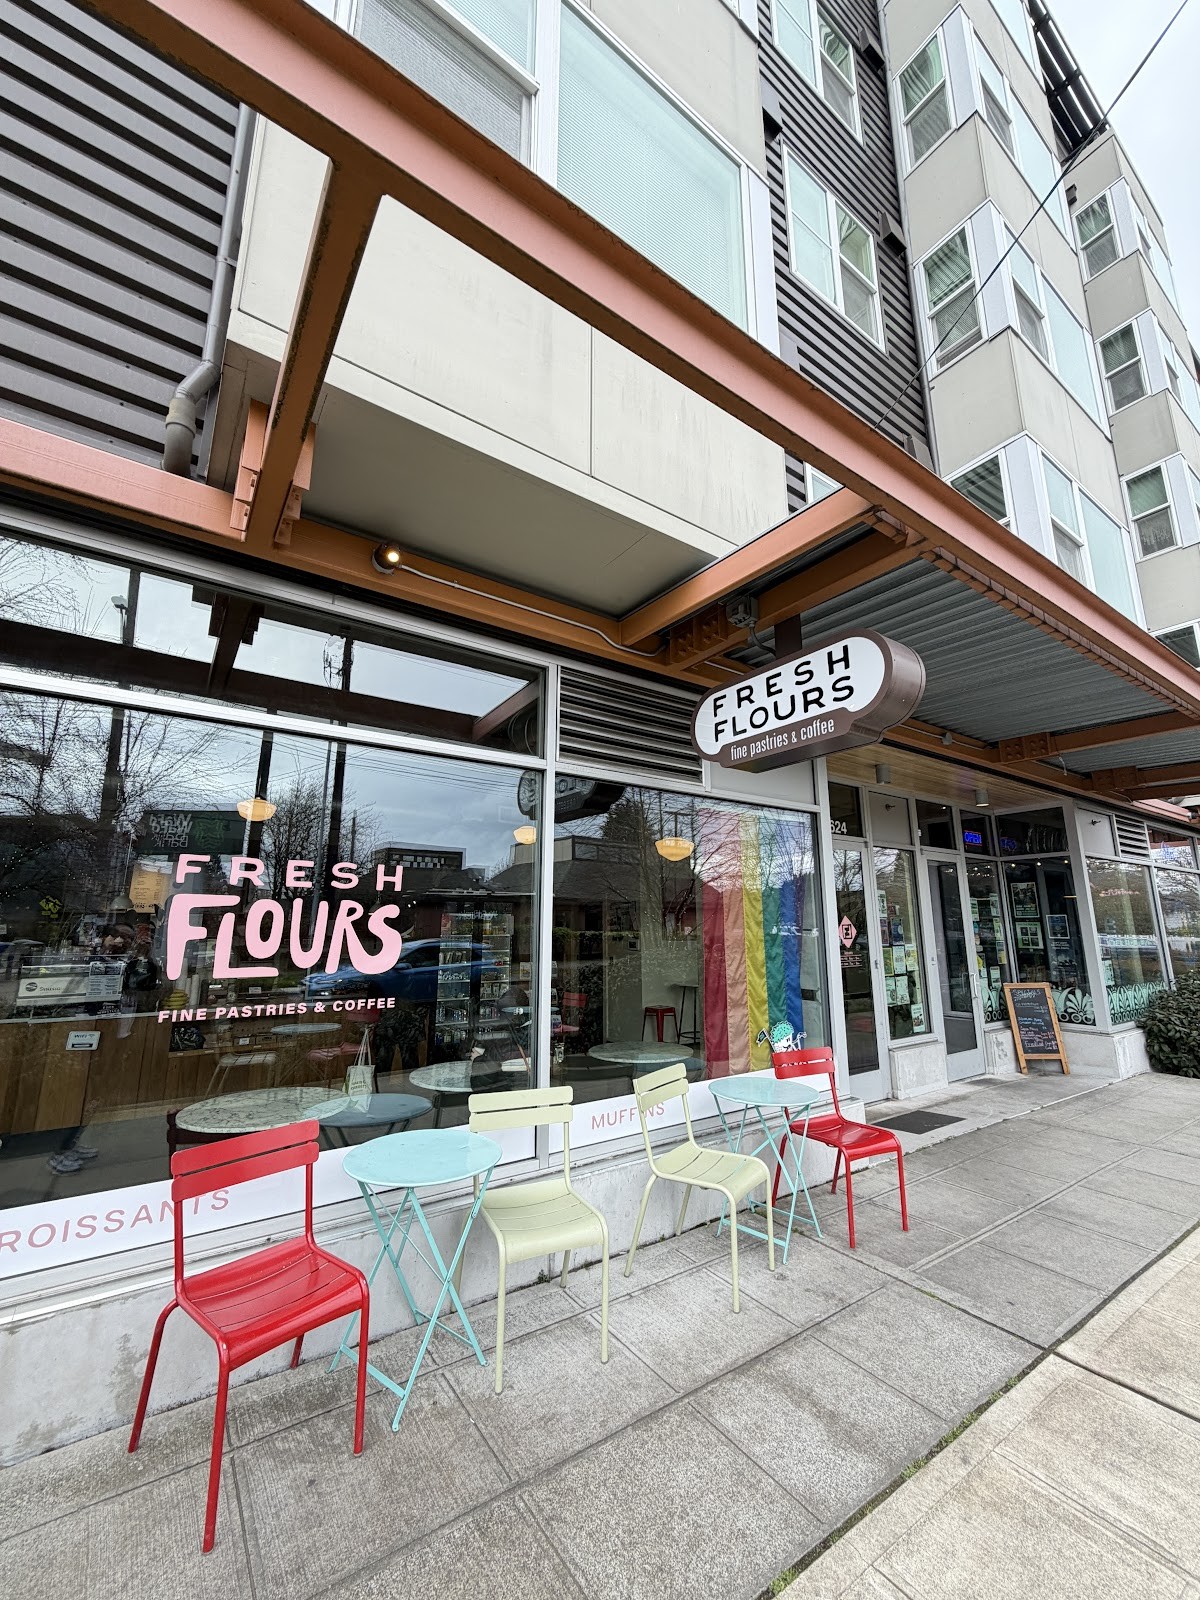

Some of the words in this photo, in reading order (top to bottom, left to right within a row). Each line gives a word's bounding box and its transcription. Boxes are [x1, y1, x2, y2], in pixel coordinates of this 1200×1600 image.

[713, 644, 850, 717] FRESH
[714, 675, 855, 743] FLOURS
[730, 745, 748, 761] fine
[750, 732, 788, 758] pastries
[791, 731, 798, 744] &
[800, 719, 835, 741] coffee
[175, 853, 403, 892] FRESH
[166, 893, 402, 981] FLOURS
[158, 1008, 207, 1023] FINE
[215, 1003, 308, 1019] PASTRIES
[313, 1001, 326, 1013] &
[332, 998, 396, 1012] COFFEE
[591, 1102, 665, 1130] MUFFNS
[0, 1189, 230, 1253] ROISSANTS
